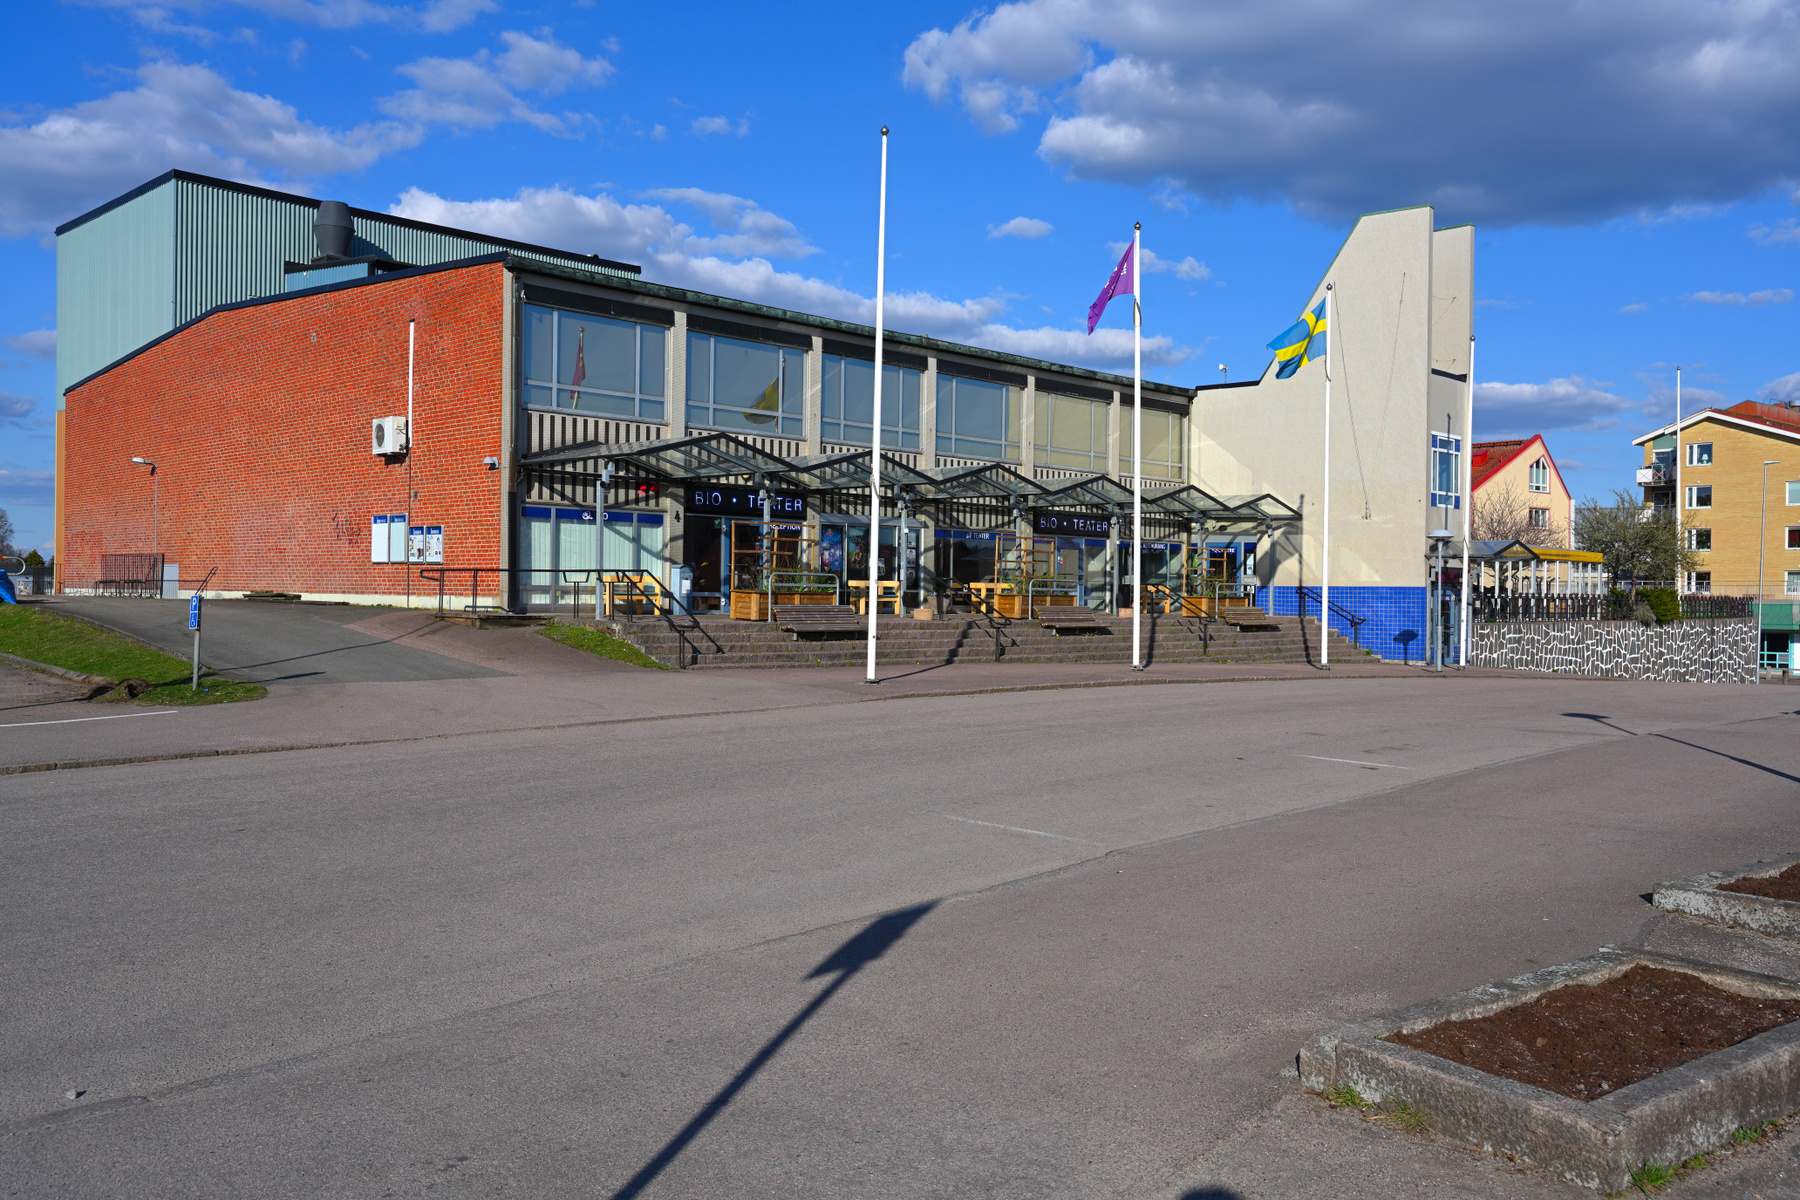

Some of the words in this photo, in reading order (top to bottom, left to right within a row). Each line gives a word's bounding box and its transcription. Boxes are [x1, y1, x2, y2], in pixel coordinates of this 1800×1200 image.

[695, 491, 722, 506] BIO
[747, 494, 803, 511] TETER
[674, 510, 681, 522] 4
[1040, 517, 1058, 529] BIO
[1073, 519, 1109, 532] TEATER
[973, 532, 990, 540] TEATER
[191, 597, 197, 610] P
